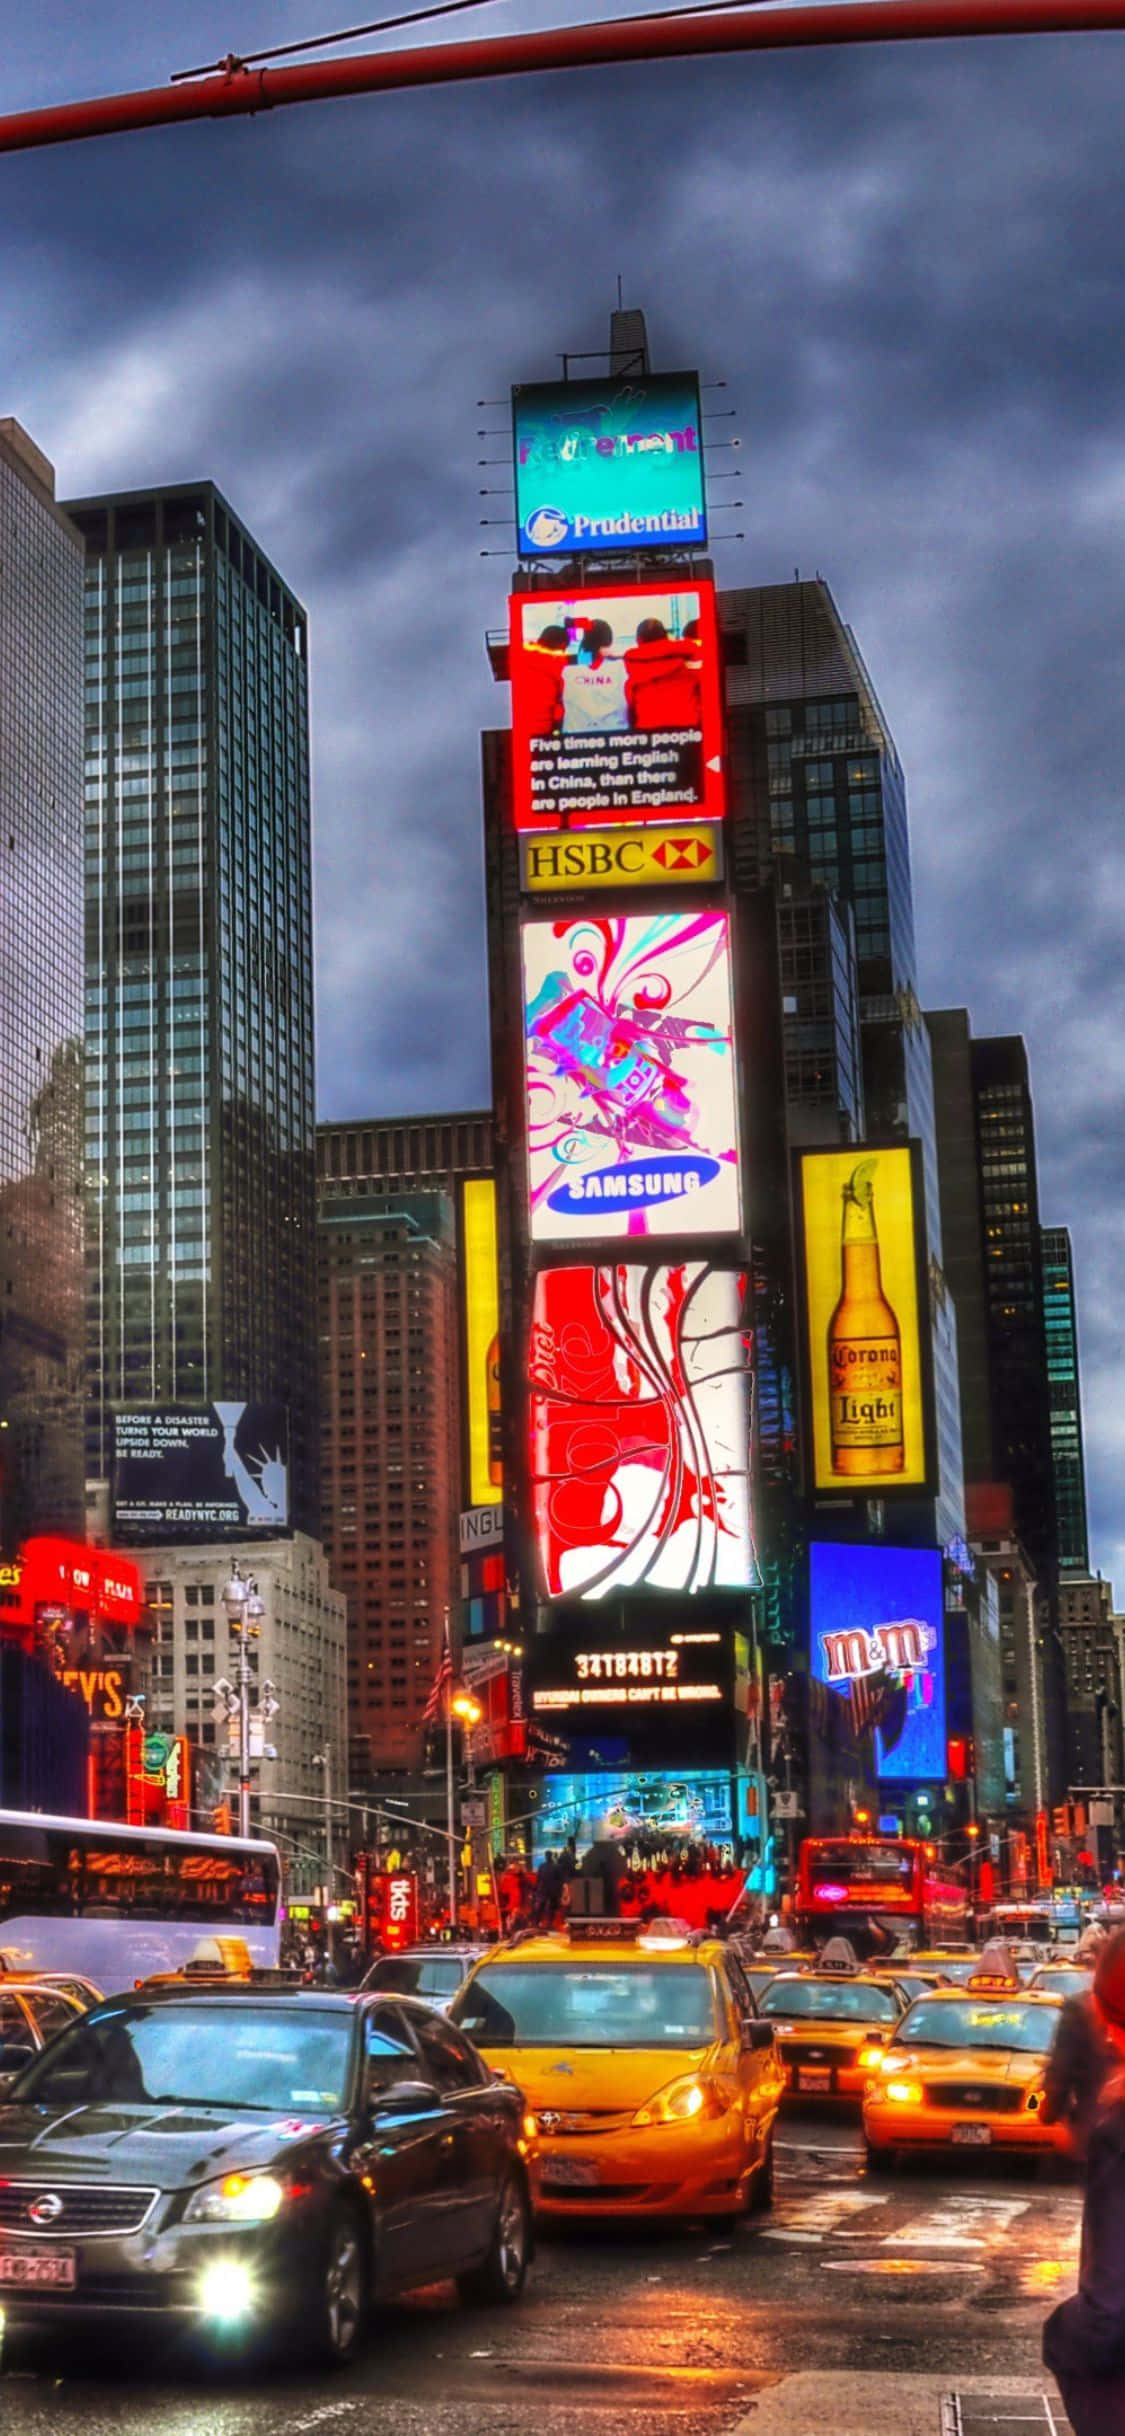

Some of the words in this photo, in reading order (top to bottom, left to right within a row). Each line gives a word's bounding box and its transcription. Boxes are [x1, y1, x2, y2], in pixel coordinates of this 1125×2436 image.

[573, 507, 699, 538] Prudential
[529, 738, 561, 752] Five
[564, 736, 606, 751] times
[609, 735, 648, 747] more
[652, 729, 702, 745] people
[530, 760, 554, 772] are
[557, 754, 618, 770] learning
[621, 750, 679, 768] English
[531, 779, 544, 791] in
[549, 775, 597, 790] China,
[600, 773, 634, 787] than
[637, 770, 676, 784] there
[531, 799, 556, 811] are
[558, 794, 610, 812] people
[613, 792, 628, 805] in
[631, 788, 698, 807] England.
[529, 841, 645, 877] HSBC
[568, 1171, 701, 1199] SAMSUNG
[833, 1344, 897, 1368] Corona
[115, 1415, 151, 1425] BEFORE
[154, 1415, 162, 1425] A
[165, 1416, 209, 1425] DISASTER
[840, 1395, 895, 1424] Light
[116, 1427, 148, 1436] TURNS
[151, 1427, 180, 1437] YOUR
[182, 1428, 218, 1437] WORLD
[116, 1438, 150, 1447] UPSIDE
[153, 1438, 190, 1448] DOWN,
[116, 1450, 128, 1458] BE
[131, 1450, 164, 1459] READY.
[165, 1509, 239, 1521] READYNYC.ORG
[511, 1671, 522, 1718] Travelex
[390, 1879, 411, 1921] tkts
